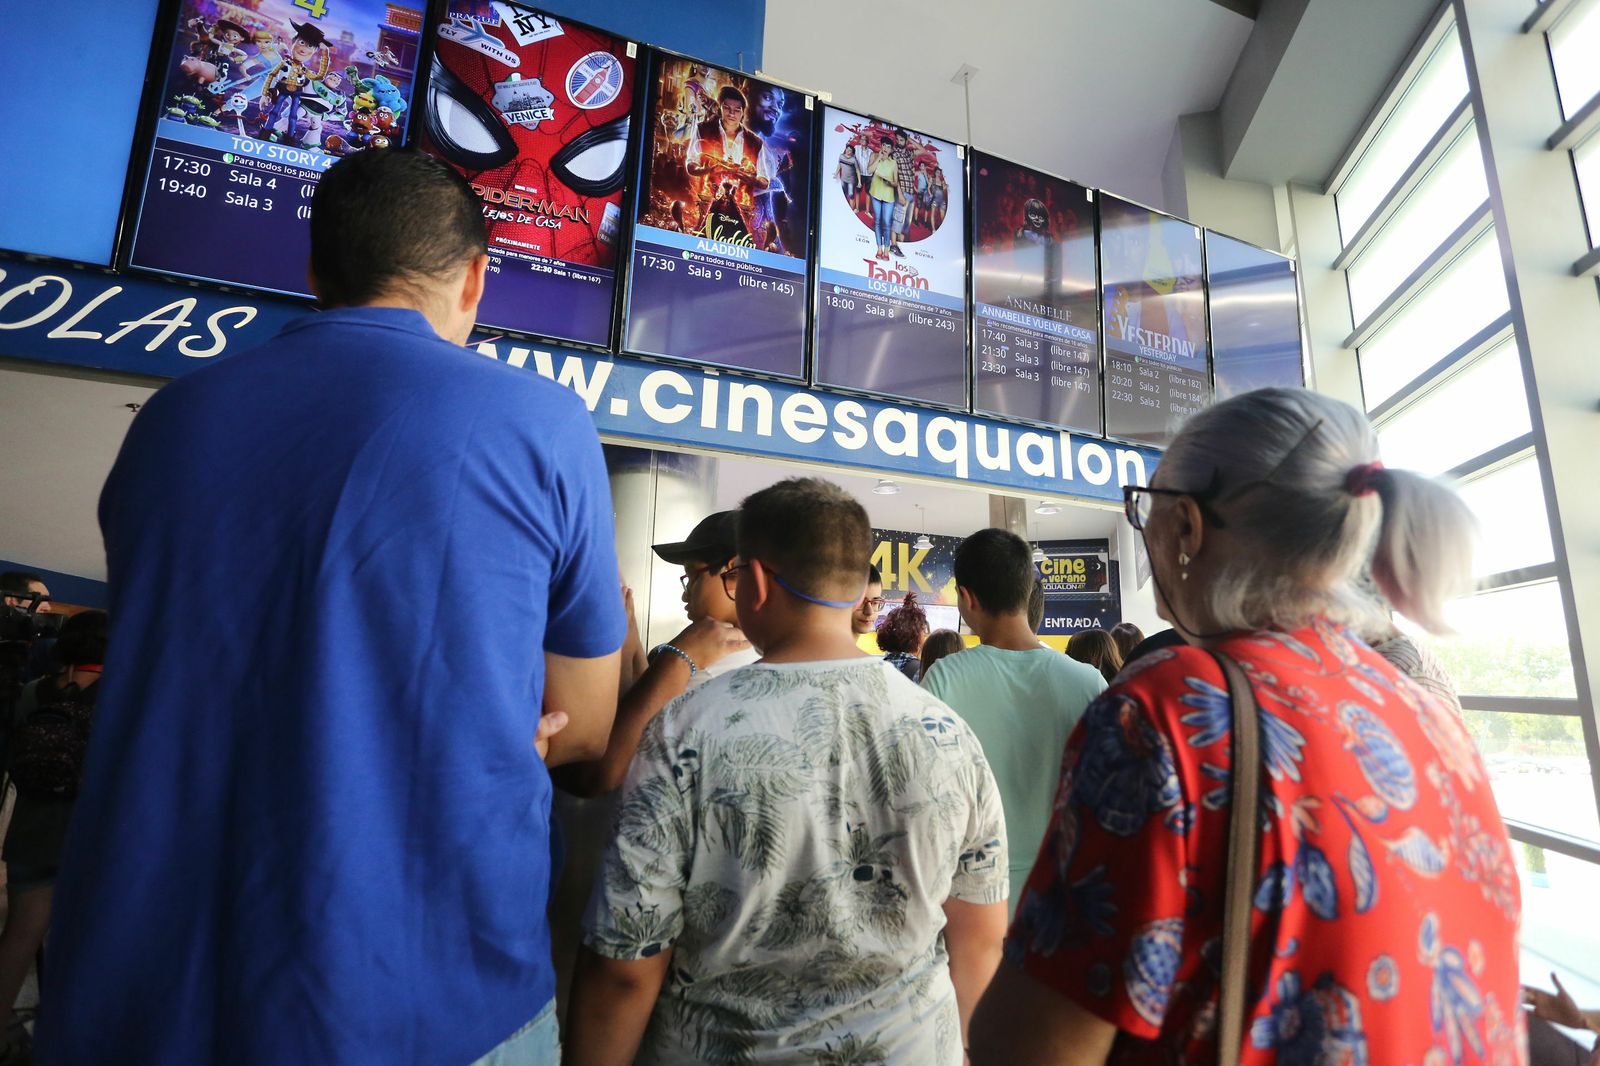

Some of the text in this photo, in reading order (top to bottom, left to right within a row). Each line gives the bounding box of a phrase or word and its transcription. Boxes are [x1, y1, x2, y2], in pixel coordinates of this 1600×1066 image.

[449, 12, 499, 25] PRAGUE
[513, 12, 551, 36] NY
[440, 27, 457, 37] FLY
[480, 42, 517, 64] WITH US
[506, 109, 549, 123] VENICE
[231, 136, 333, 169] TOY STORY 4
[162, 155, 315, 199] 17:30 Sala 4 (li
[233, 155, 321, 181] Para todos los públi
[158, 177, 312, 219] 19:40 Sala 3 (li
[469, 182, 590, 224] PIDER-MAN
[535, 216, 562, 230] CASA
[719, 213, 739, 226] Disney
[495, 236, 542, 251] PRÓXIMAMENTE
[696, 239, 749, 260] ALADDÍN
[506, 250, 518, 258] para
[519, 253, 541, 262] menores
[690, 252, 763, 274] Para todos los públicos
[895, 260, 909, 273] los
[530, 263, 553, 274] 22:30
[553, 268, 567, 277] Sala
[572, 272, 588, 282] (libre
[588, 275, 602, 284] 167)
[641, 255, 795, 297] 17:30 Sala 9 (libre 145)
[840, 287, 849, 295] No
[850, 290, 888, 302] recomendada
[889, 297, 902, 306] para
[903, 300, 926, 311] menores
[927, 304, 934, 312] de
[940, 307, 952, 316] años
[868, 279, 921, 300] LOS JAPÓN
[0, 268, 258, 358] OLAS
[825, 295, 955, 332] 18:00 Sala 8 (libre 243)
[1004, 295, 1073, 321] ANNABELLE
[981, 306, 1092, 342] ANNABELLE VUELVE A CASA
[992, 320, 1000, 328] No
[1000, 323, 1032, 335] recomendada
[1033, 330, 1043, 340] para
[1044, 334, 1064, 344] menores
[1117, 314, 1196, 358] YESTERDAY
[981, 328, 1090, 363] 17:40 Sala 3 (libre 147)
[1139, 345, 1177, 362] YESTERDAY
[981, 344, 1090, 379] 21:30 Sala 3 (libre 147)
[981, 361, 1091, 394] 23:30 Sala 3 (libre 147)
[1111, 359, 1202, 390] 18:10 Sala 2 (libre 182)
[1111, 375, 1203, 405] 20:20 Sala 2 (libre 184)
[1111, 389, 1133, 403] 22:30
[1140, 396, 1155, 407] Sala
[1155, 399, 1161, 409] 2
[1169, 402, 1188, 414] (libre
[870, 541, 934, 593] 4K
[1040, 558, 1086, 575] cine
[1048, 574, 1087, 583] verano
[1044, 617, 1102, 628] ENTRADA
